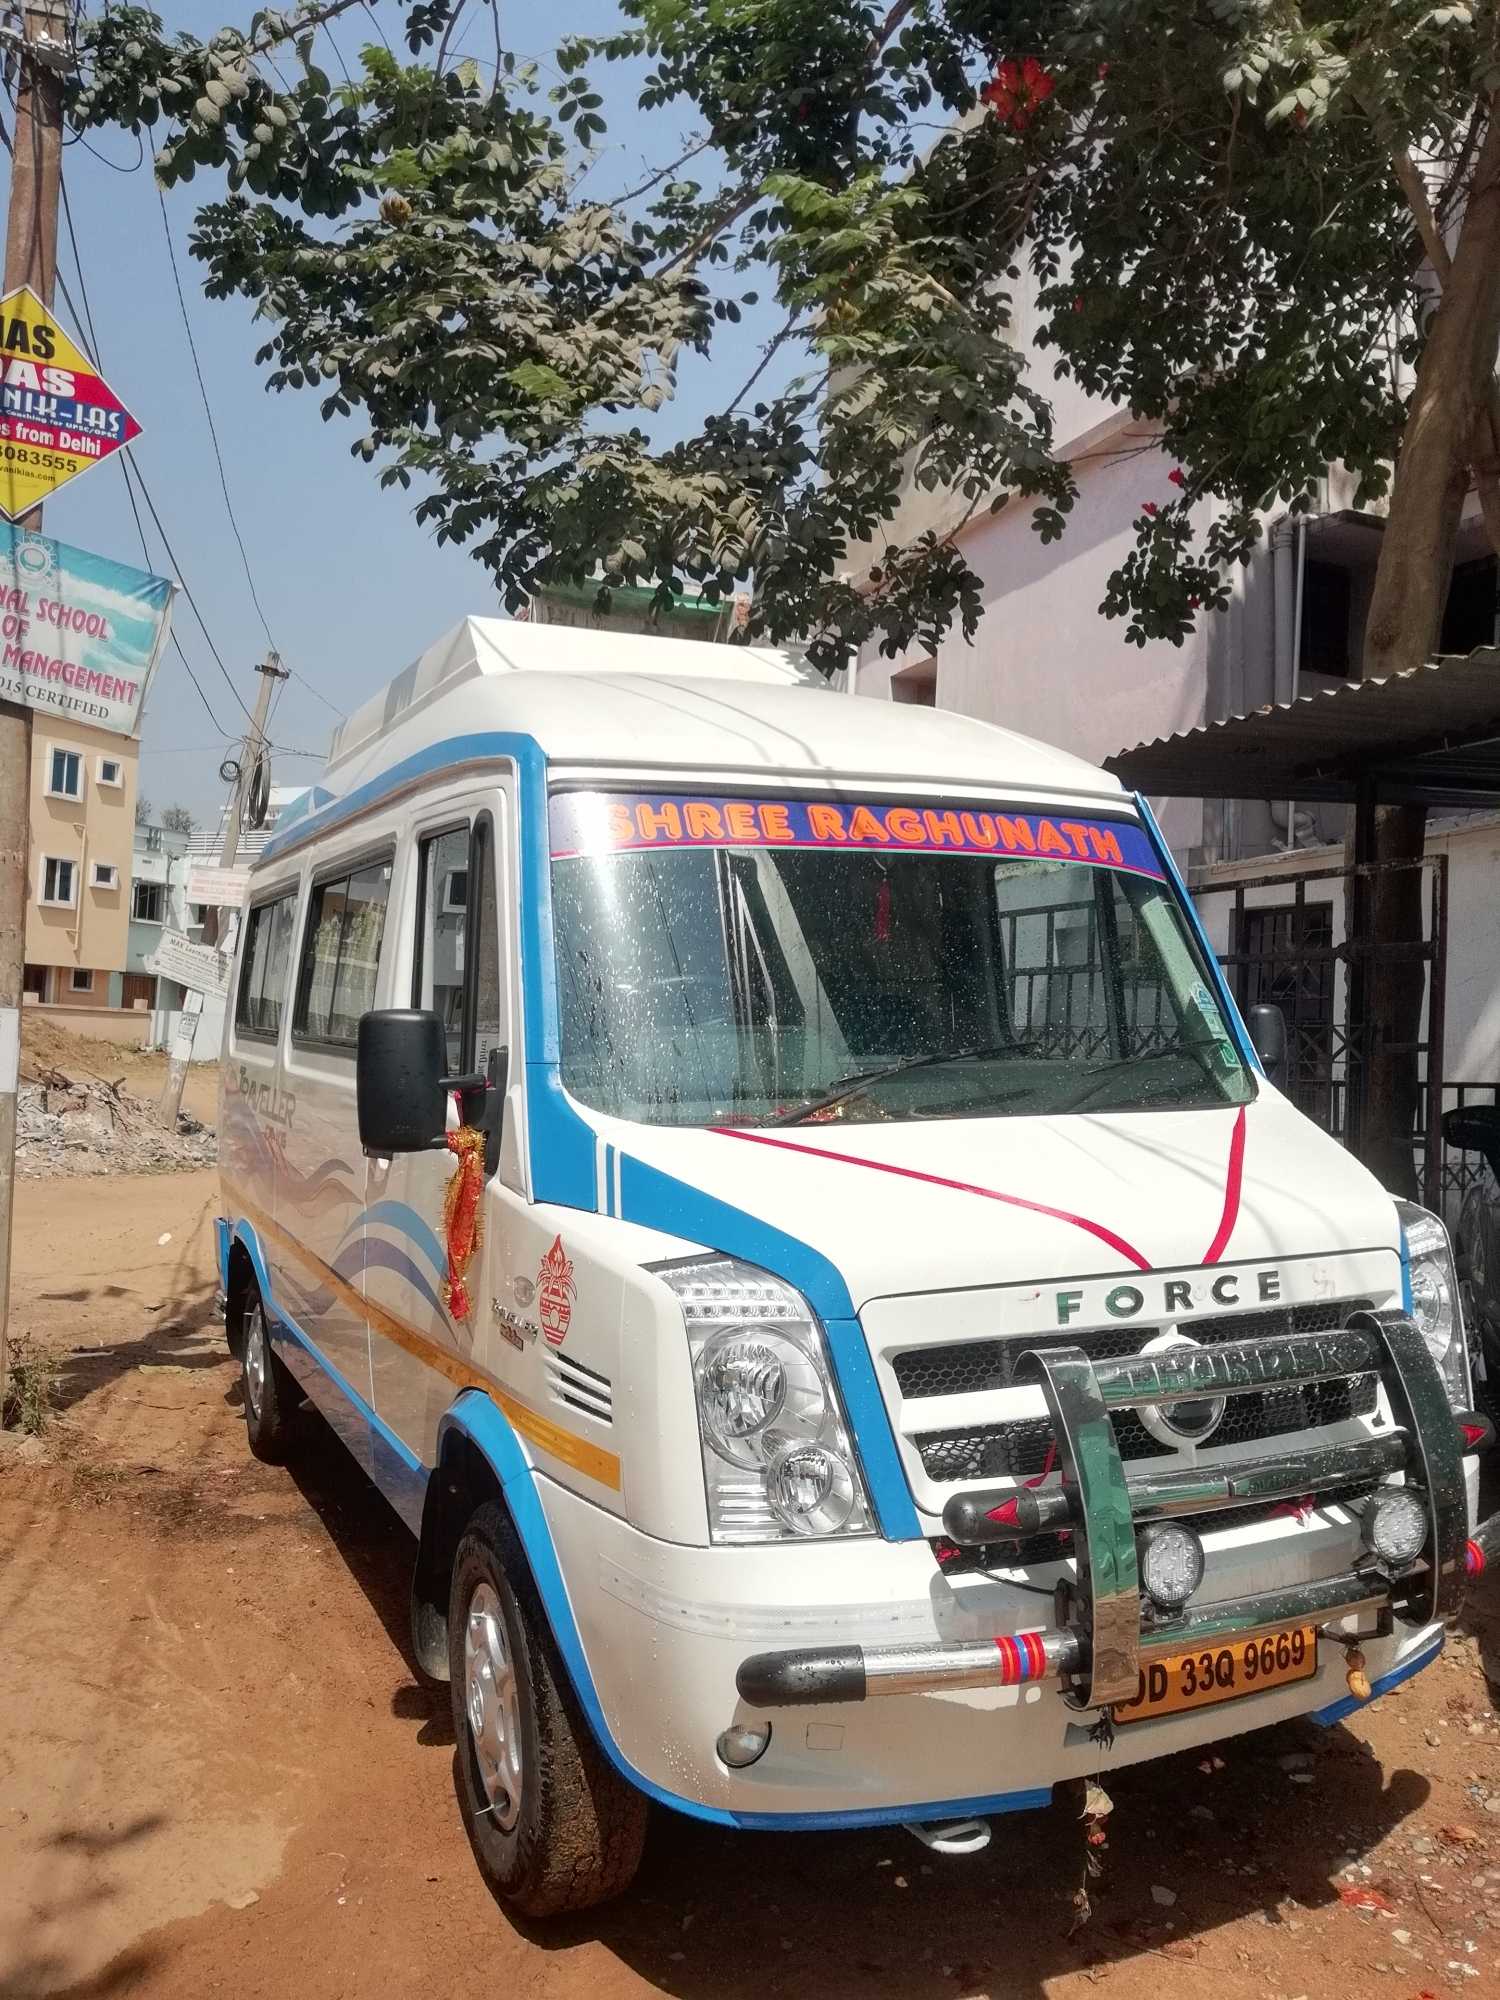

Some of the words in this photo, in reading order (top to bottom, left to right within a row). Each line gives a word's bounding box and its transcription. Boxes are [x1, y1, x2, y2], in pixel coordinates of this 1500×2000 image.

[0, 358, 76, 398] AS
[0, 422, 10, 437] s
[15, 422, 54, 446] from
[60, 431, 101, 456] Delhi
[0, 445, 78, 473] 083555
[2, 614, 30, 646] OF
[36, 597, 108, 642] SCHOOL
[2, 643, 139, 705] MANAGEMENT
[25, 684, 110, 719] CERTIFIED
[608, 802, 795, 840] SHREE
[807, 804, 1124, 864] RAGHUNATH
[1056, 1270, 1281, 1326] FORCE
[1181, 1648, 1235, 1697] 33Q
[1243, 1629, 1306, 1681] 9669
